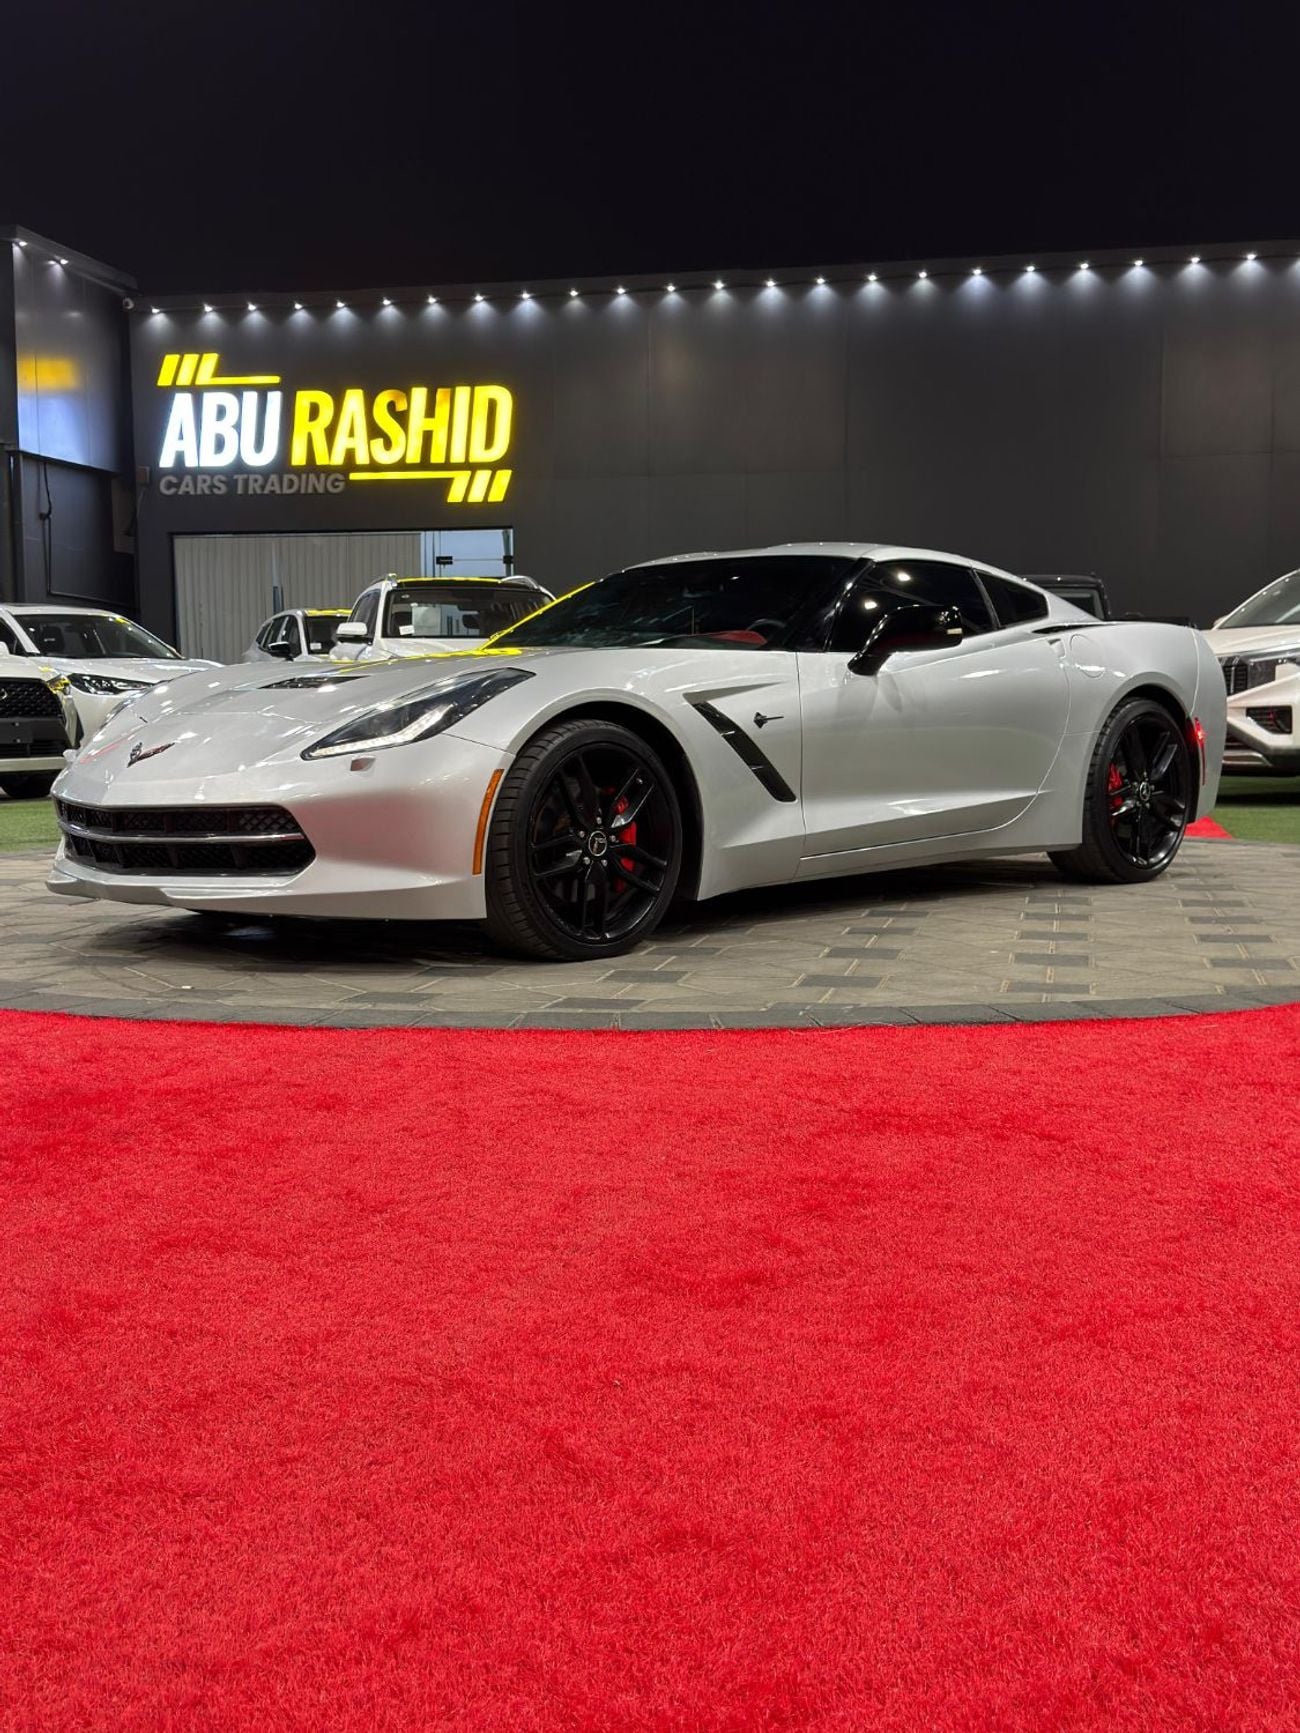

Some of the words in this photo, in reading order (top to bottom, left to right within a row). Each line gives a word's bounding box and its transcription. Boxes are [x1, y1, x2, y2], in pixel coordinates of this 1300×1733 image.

[159, 390, 282, 468] ABU
[291, 384, 514, 466] RASHID
[159, 474, 228, 496] CARS
[233, 472, 346, 495] TRADING
